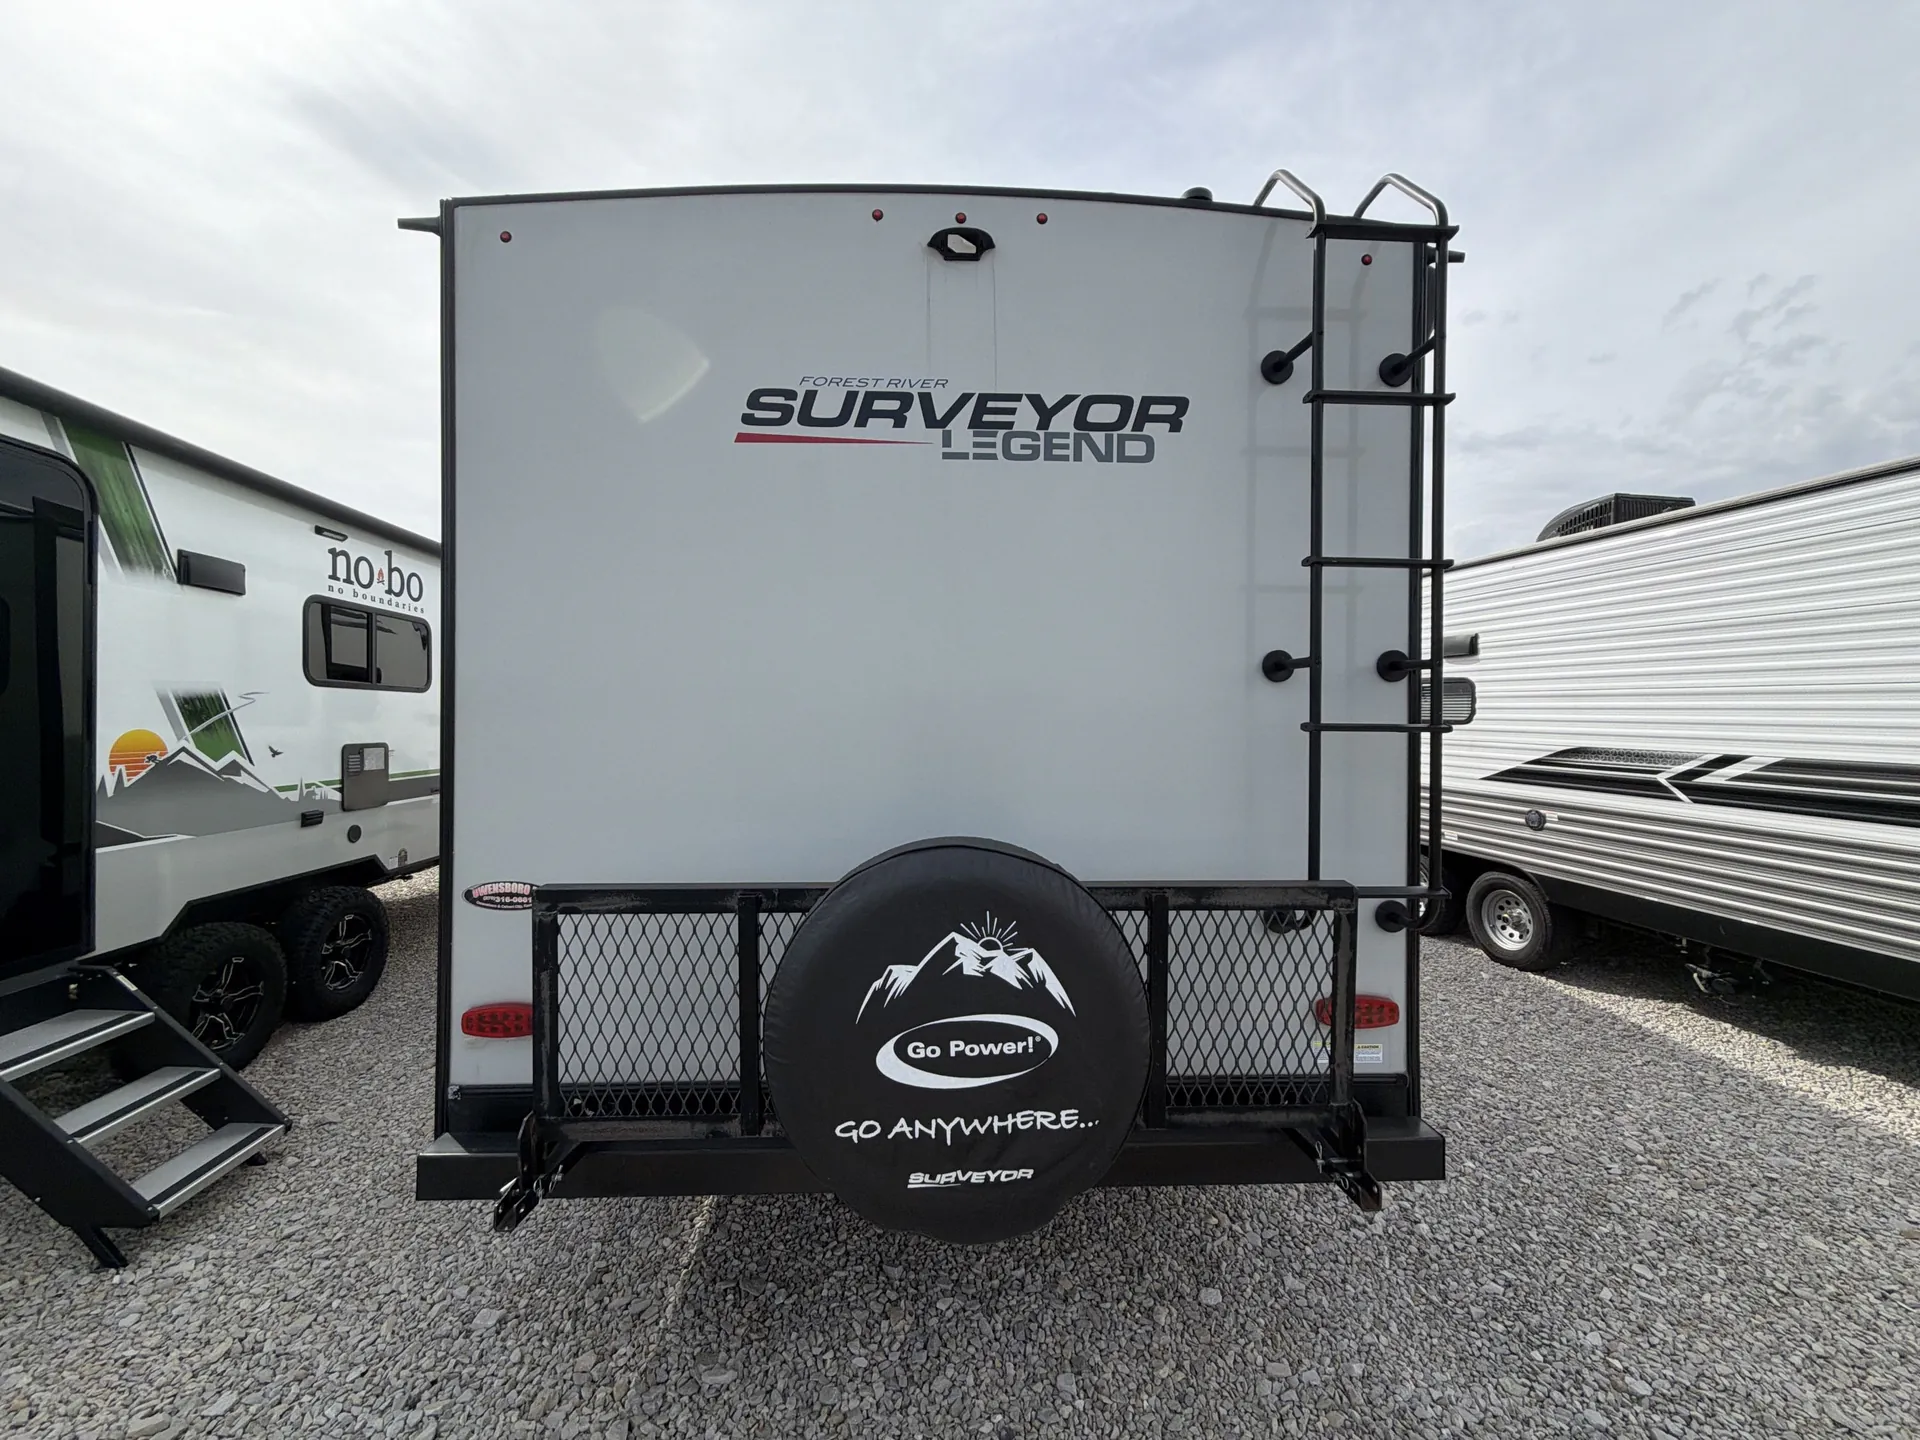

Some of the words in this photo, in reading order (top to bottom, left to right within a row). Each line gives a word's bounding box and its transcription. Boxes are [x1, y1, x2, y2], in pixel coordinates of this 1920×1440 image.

[799, 376, 884, 388] FOREST
[886, 378, 949, 389] RIVER
[740, 388, 1190, 433] SURVEYOR
[942, 429, 1155, 464] LEGEND
[328, 584, 344, 595] no
[353, 588, 425, 614] boundaries
[472, 882, 531, 898] OWENSBORO
[907, 1041, 941, 1059] Go
[835, 1120, 881, 1143] GO
[908, 1168, 1034, 1185] SURVEYOR
